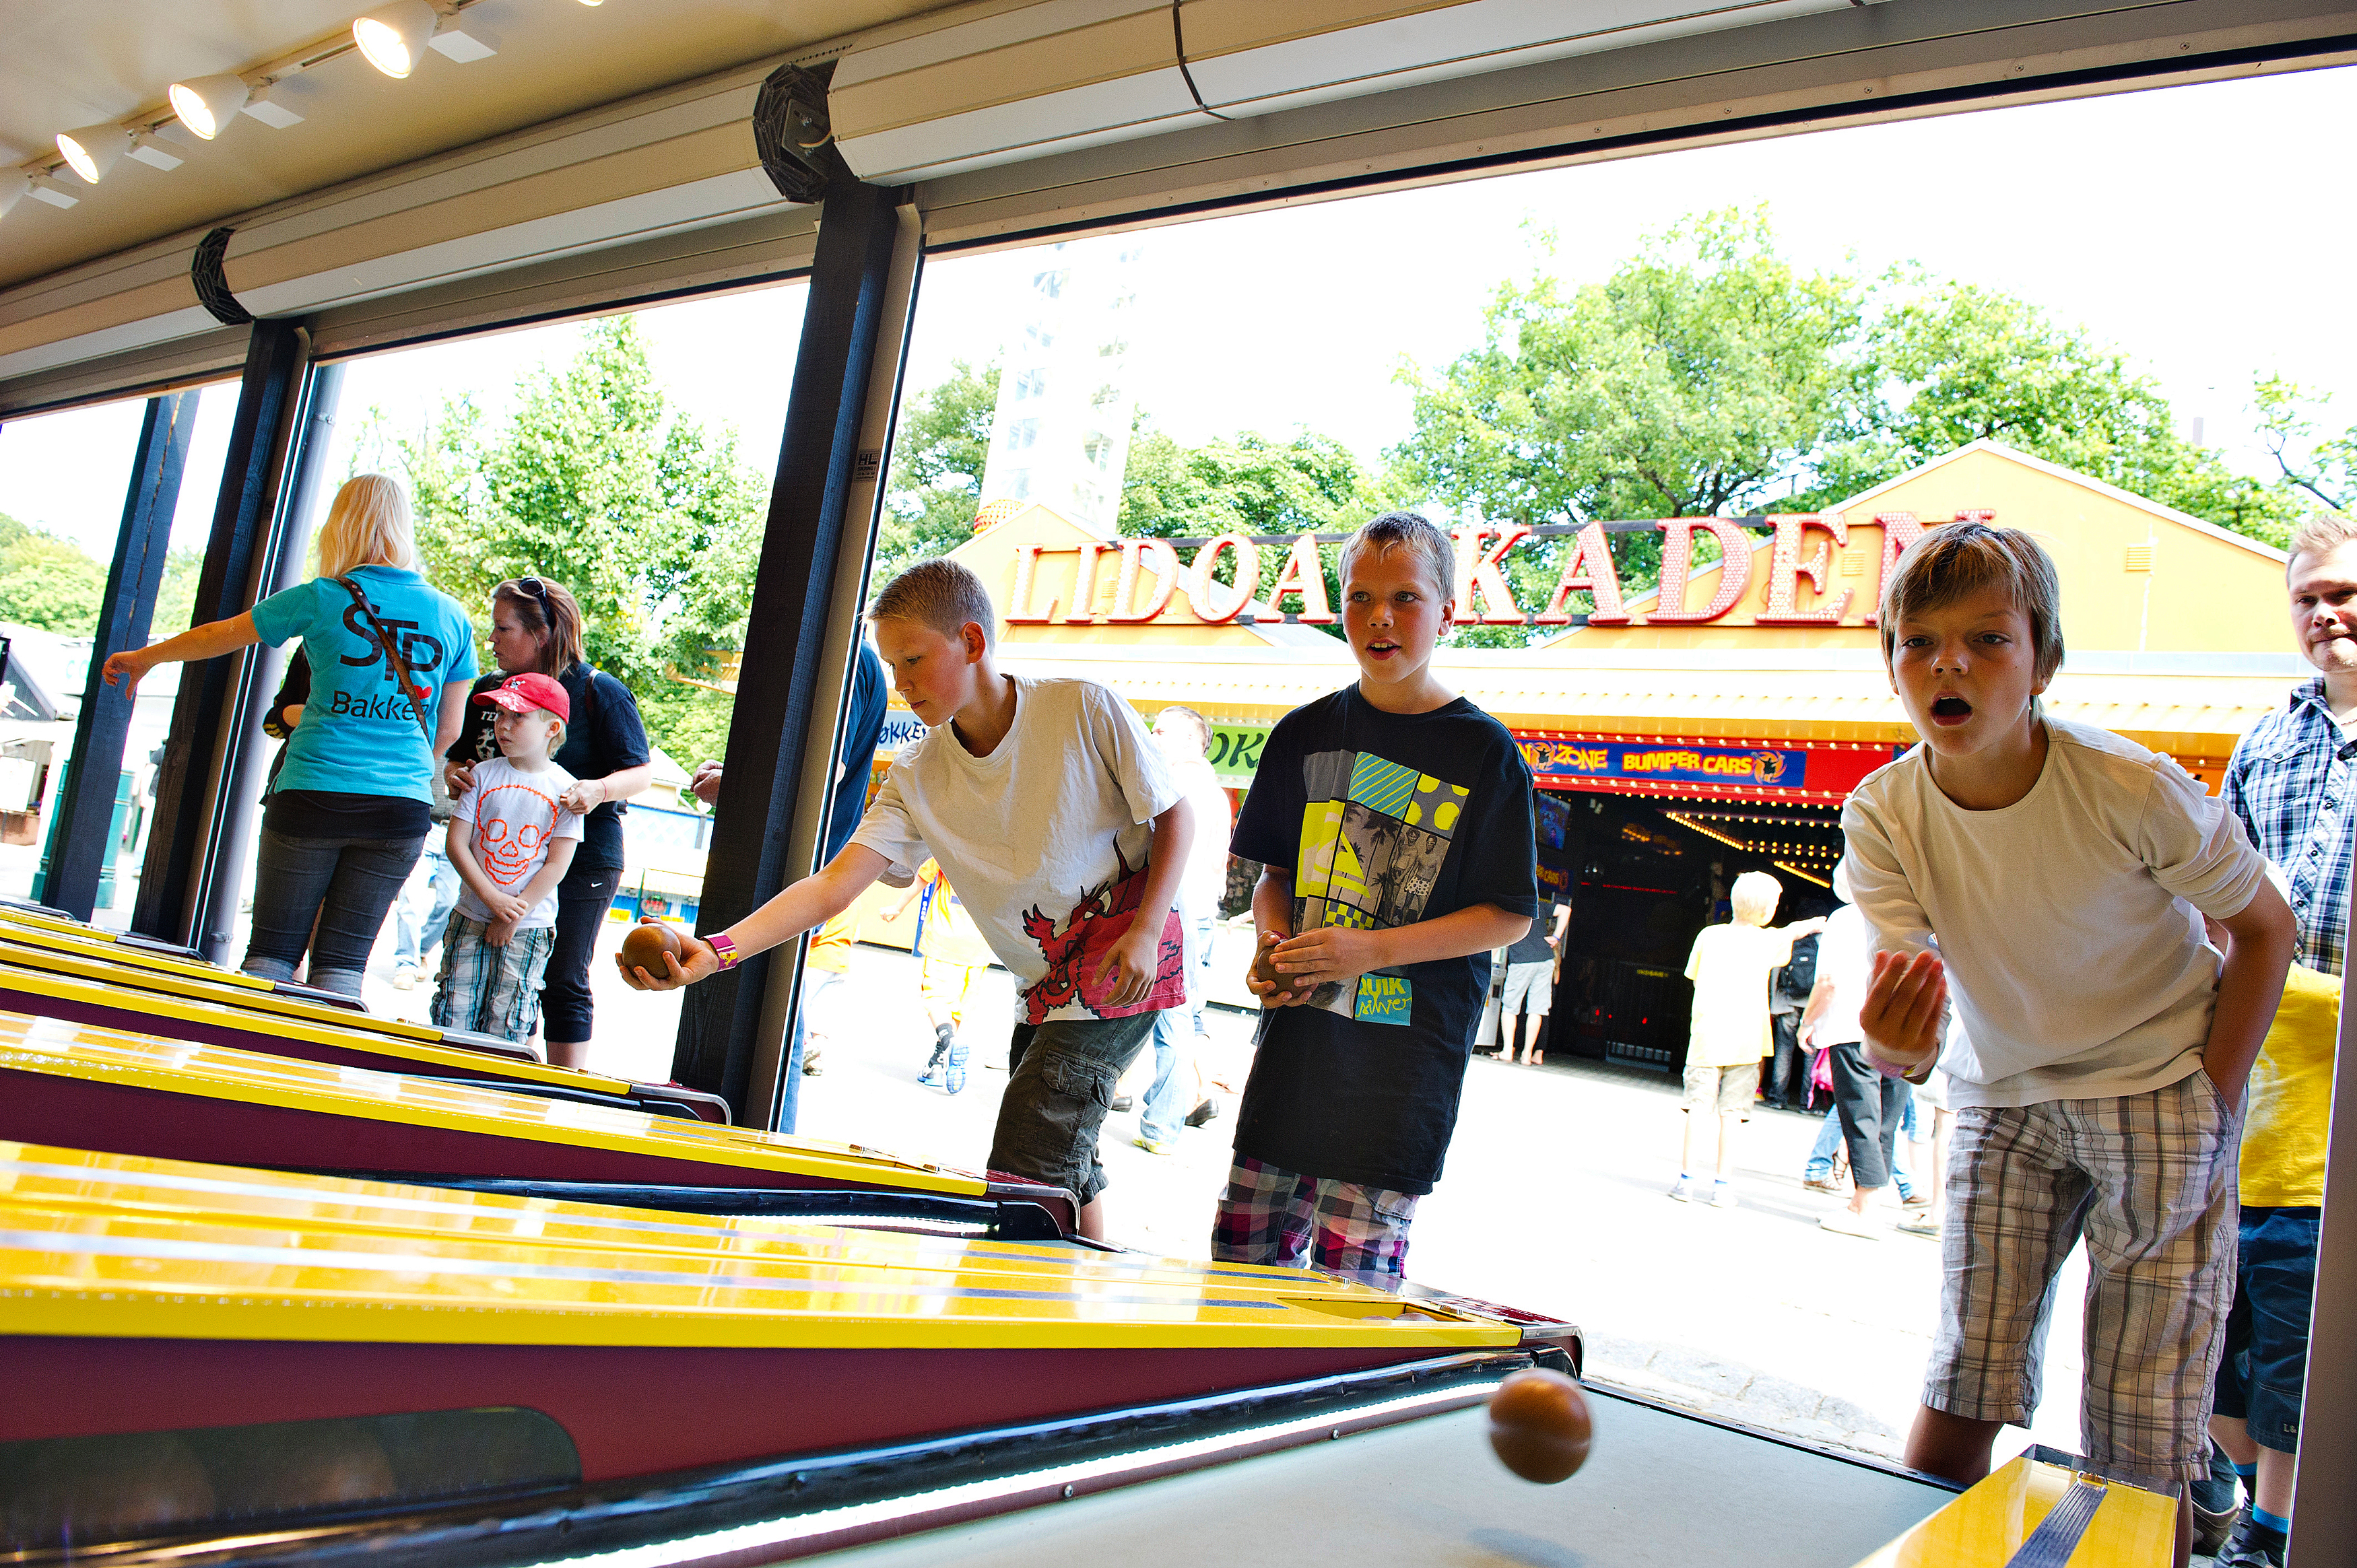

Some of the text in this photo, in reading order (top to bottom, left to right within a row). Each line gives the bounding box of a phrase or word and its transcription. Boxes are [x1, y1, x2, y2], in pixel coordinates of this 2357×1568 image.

[858, 454, 877, 465] HL
[1553, 743, 1608, 773] ZONE
[1622, 750, 1702, 772] BUMPER
[1702, 755, 1754, 776] CARS
